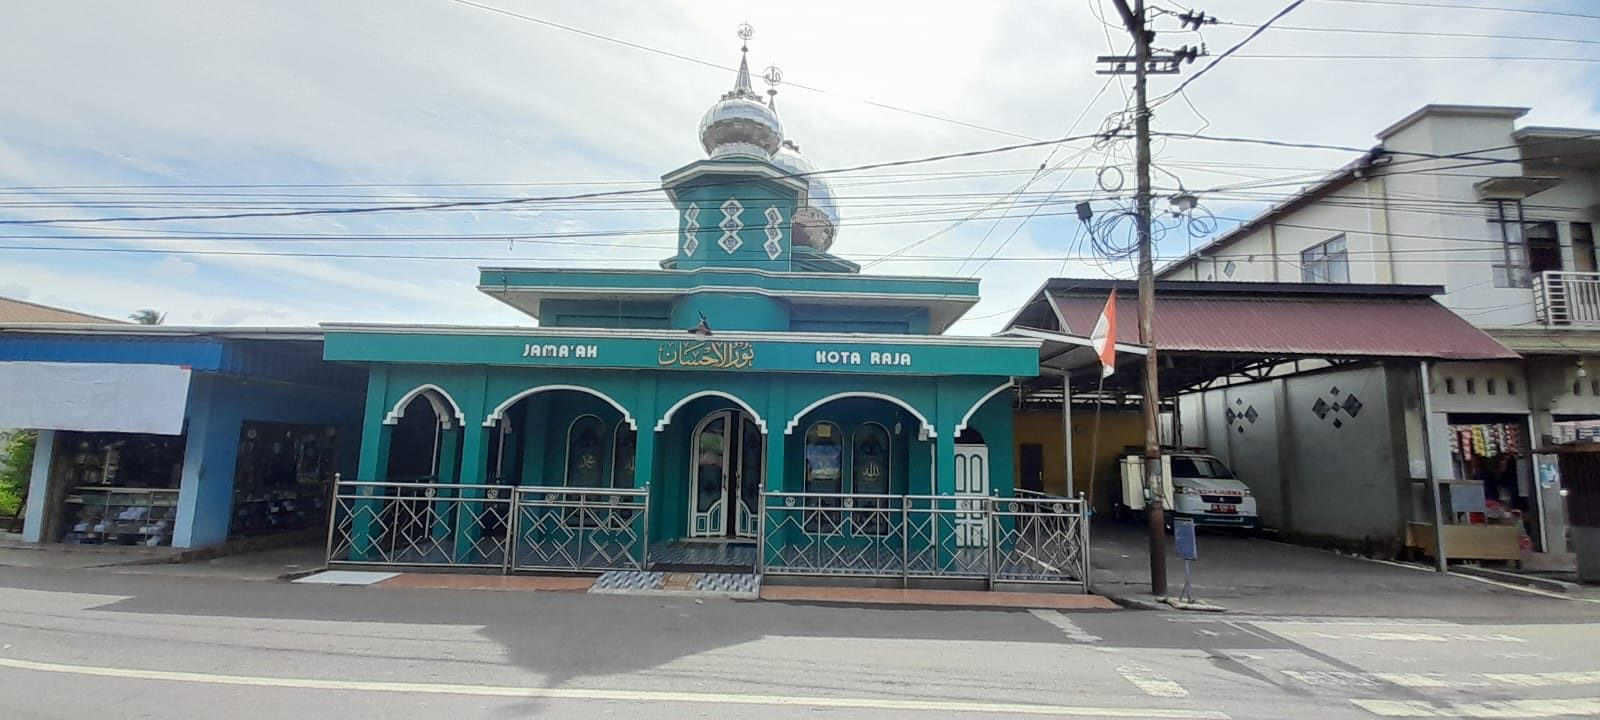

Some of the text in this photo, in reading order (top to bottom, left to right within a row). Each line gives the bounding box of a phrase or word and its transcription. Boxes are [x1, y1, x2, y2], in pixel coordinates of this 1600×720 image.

[522, 343, 598, 358] JAMA'AH
[816, 350, 911, 366] KOTA RAJA
